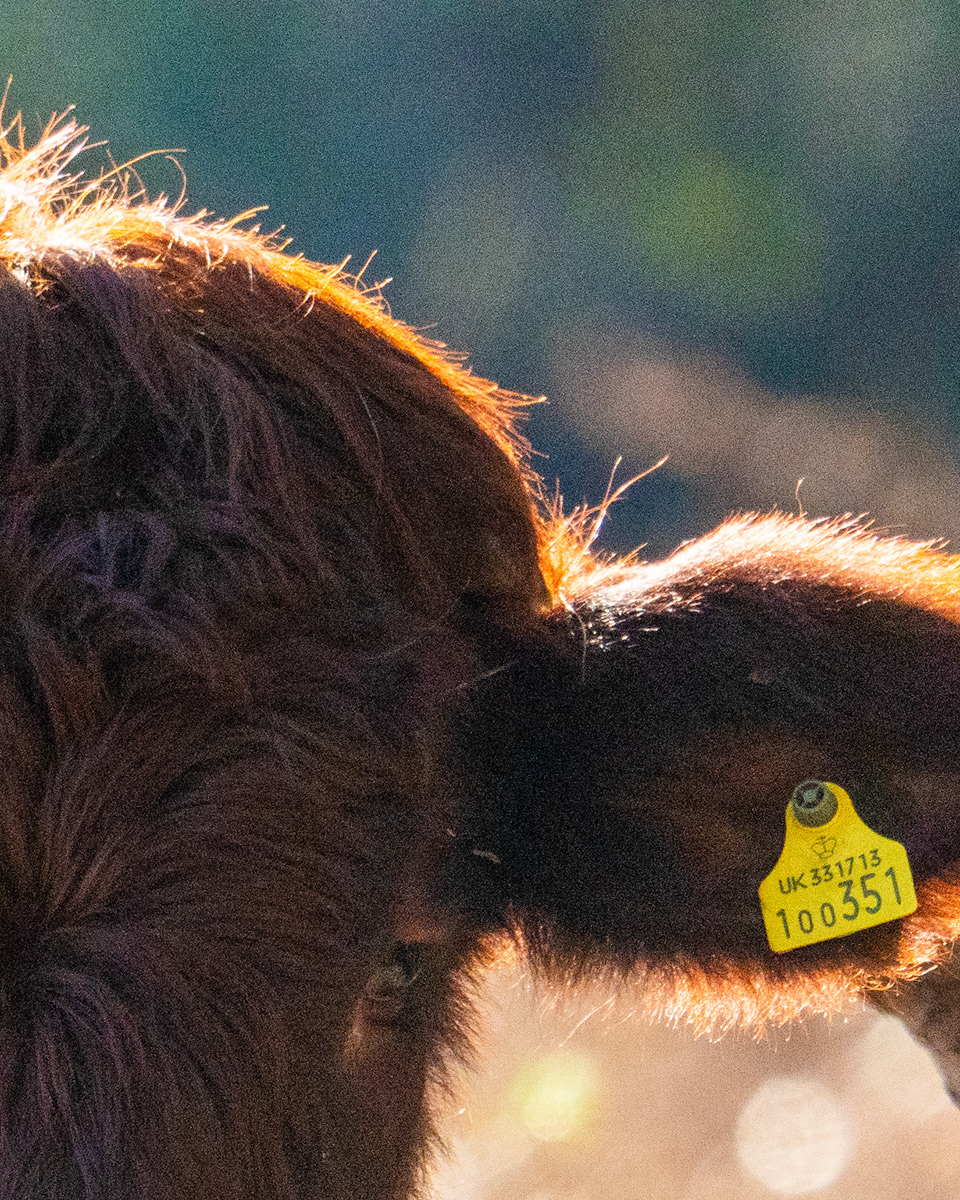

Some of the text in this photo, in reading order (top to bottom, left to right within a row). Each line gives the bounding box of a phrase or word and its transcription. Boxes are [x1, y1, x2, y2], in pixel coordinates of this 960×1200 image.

[779, 849, 882, 894] UK 331713
[777, 867, 901, 939] 100351
